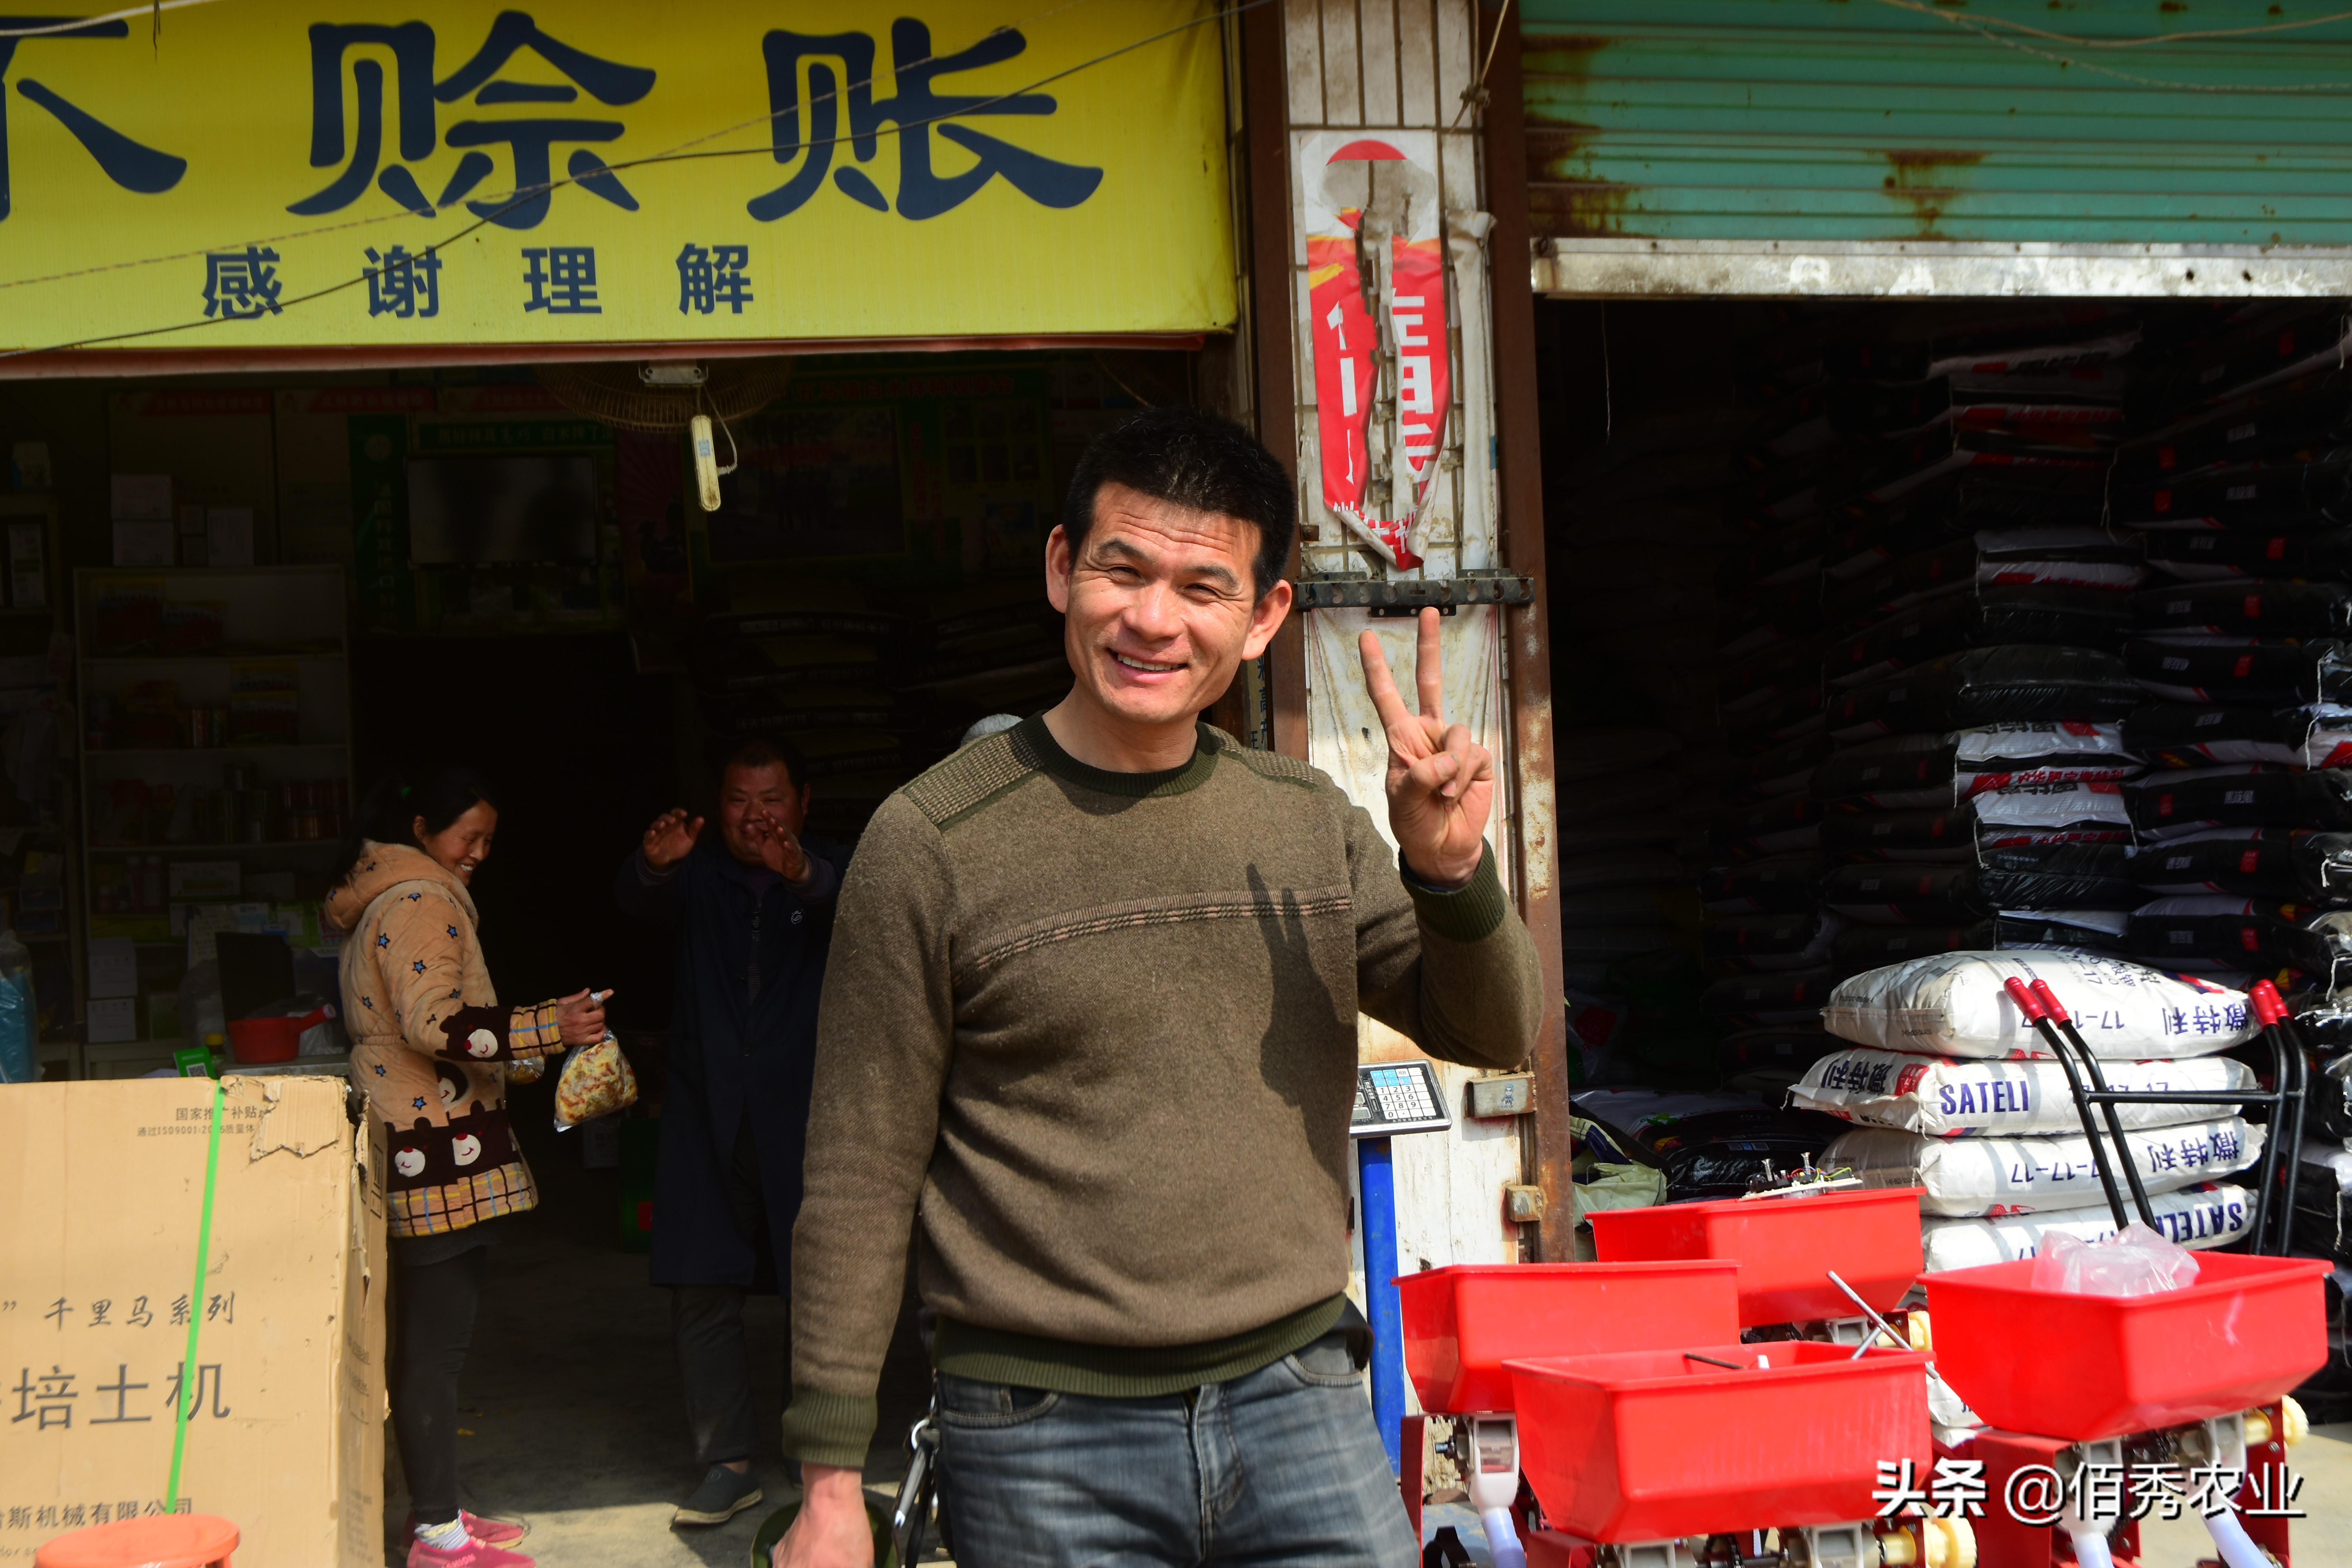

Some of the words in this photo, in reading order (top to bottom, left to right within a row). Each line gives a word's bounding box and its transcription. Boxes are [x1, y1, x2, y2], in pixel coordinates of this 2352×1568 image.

[201, 244, 755, 321] 感谢理解
[1939, 1081, 2029, 1115] SATELI
[2011, 1158, 2100, 1183] 7-17-17
